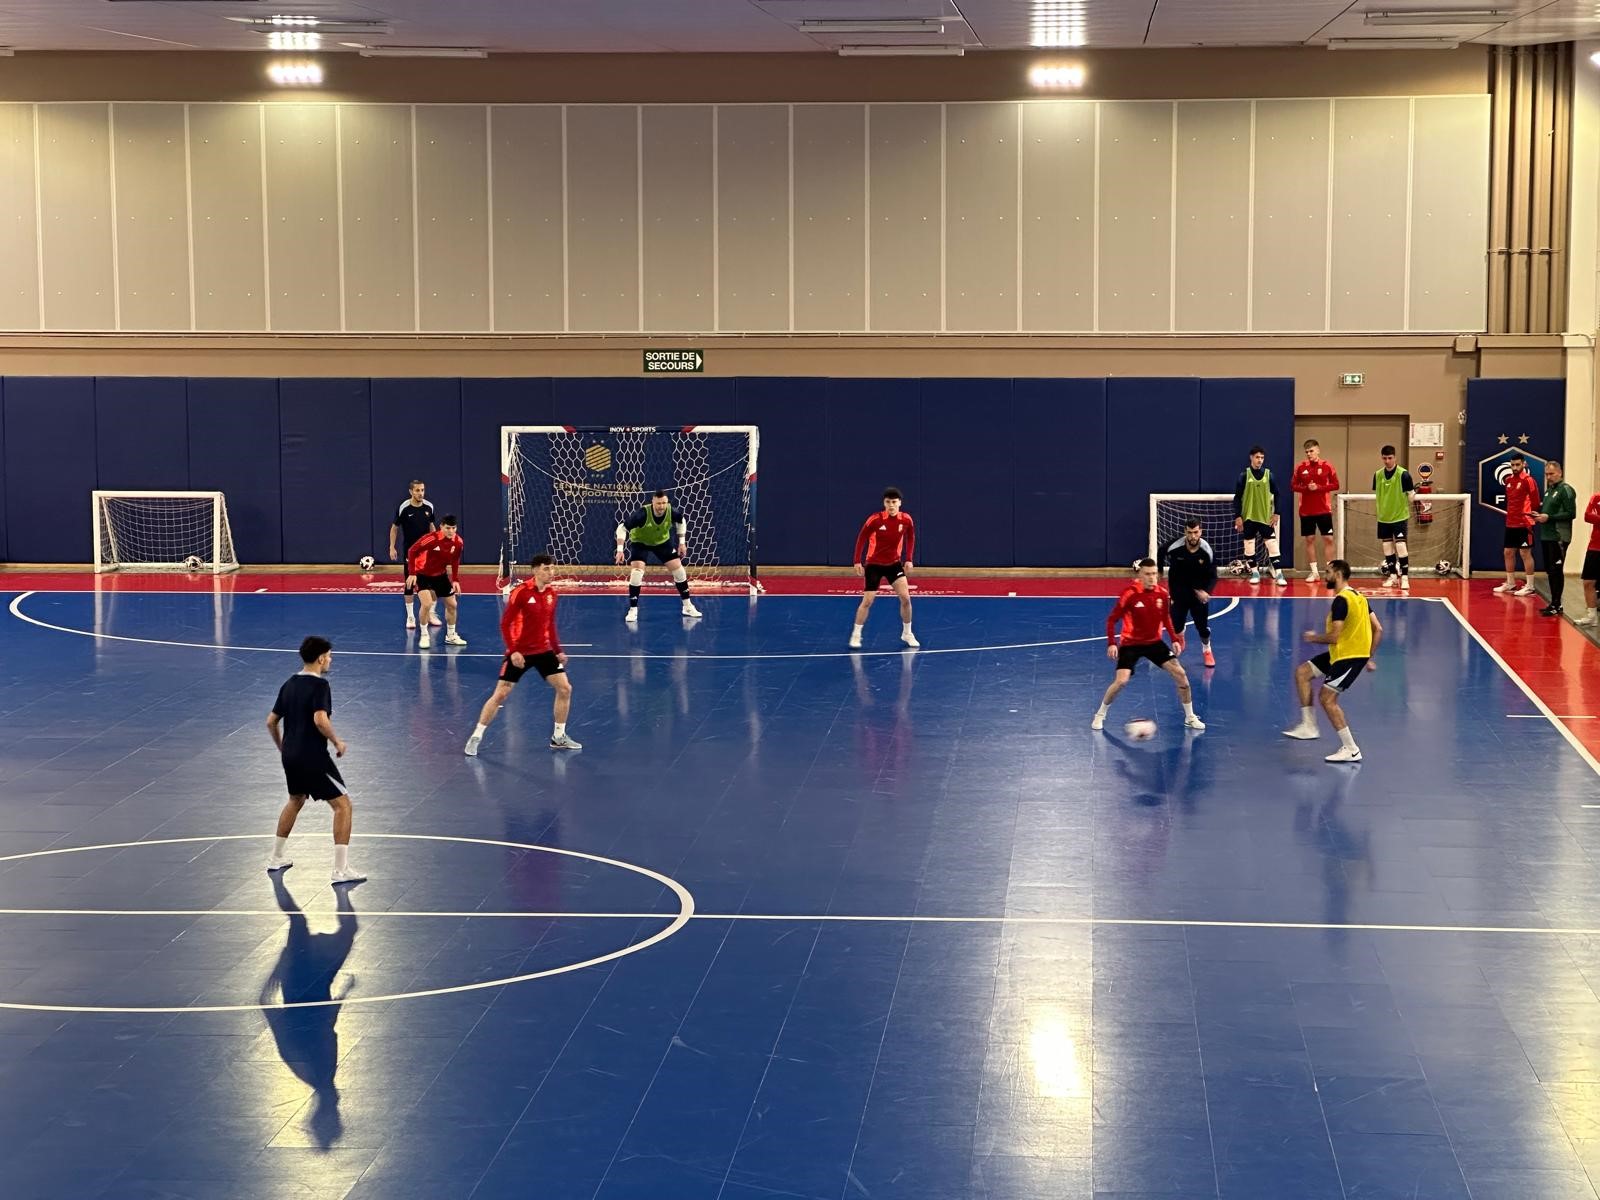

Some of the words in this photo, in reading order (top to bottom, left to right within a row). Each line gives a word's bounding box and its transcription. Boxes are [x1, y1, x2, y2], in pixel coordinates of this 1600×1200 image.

[645, 352, 680, 361] SORTIE
[682, 352, 695, 361] DE
[648, 361, 694, 370] SECOURS
